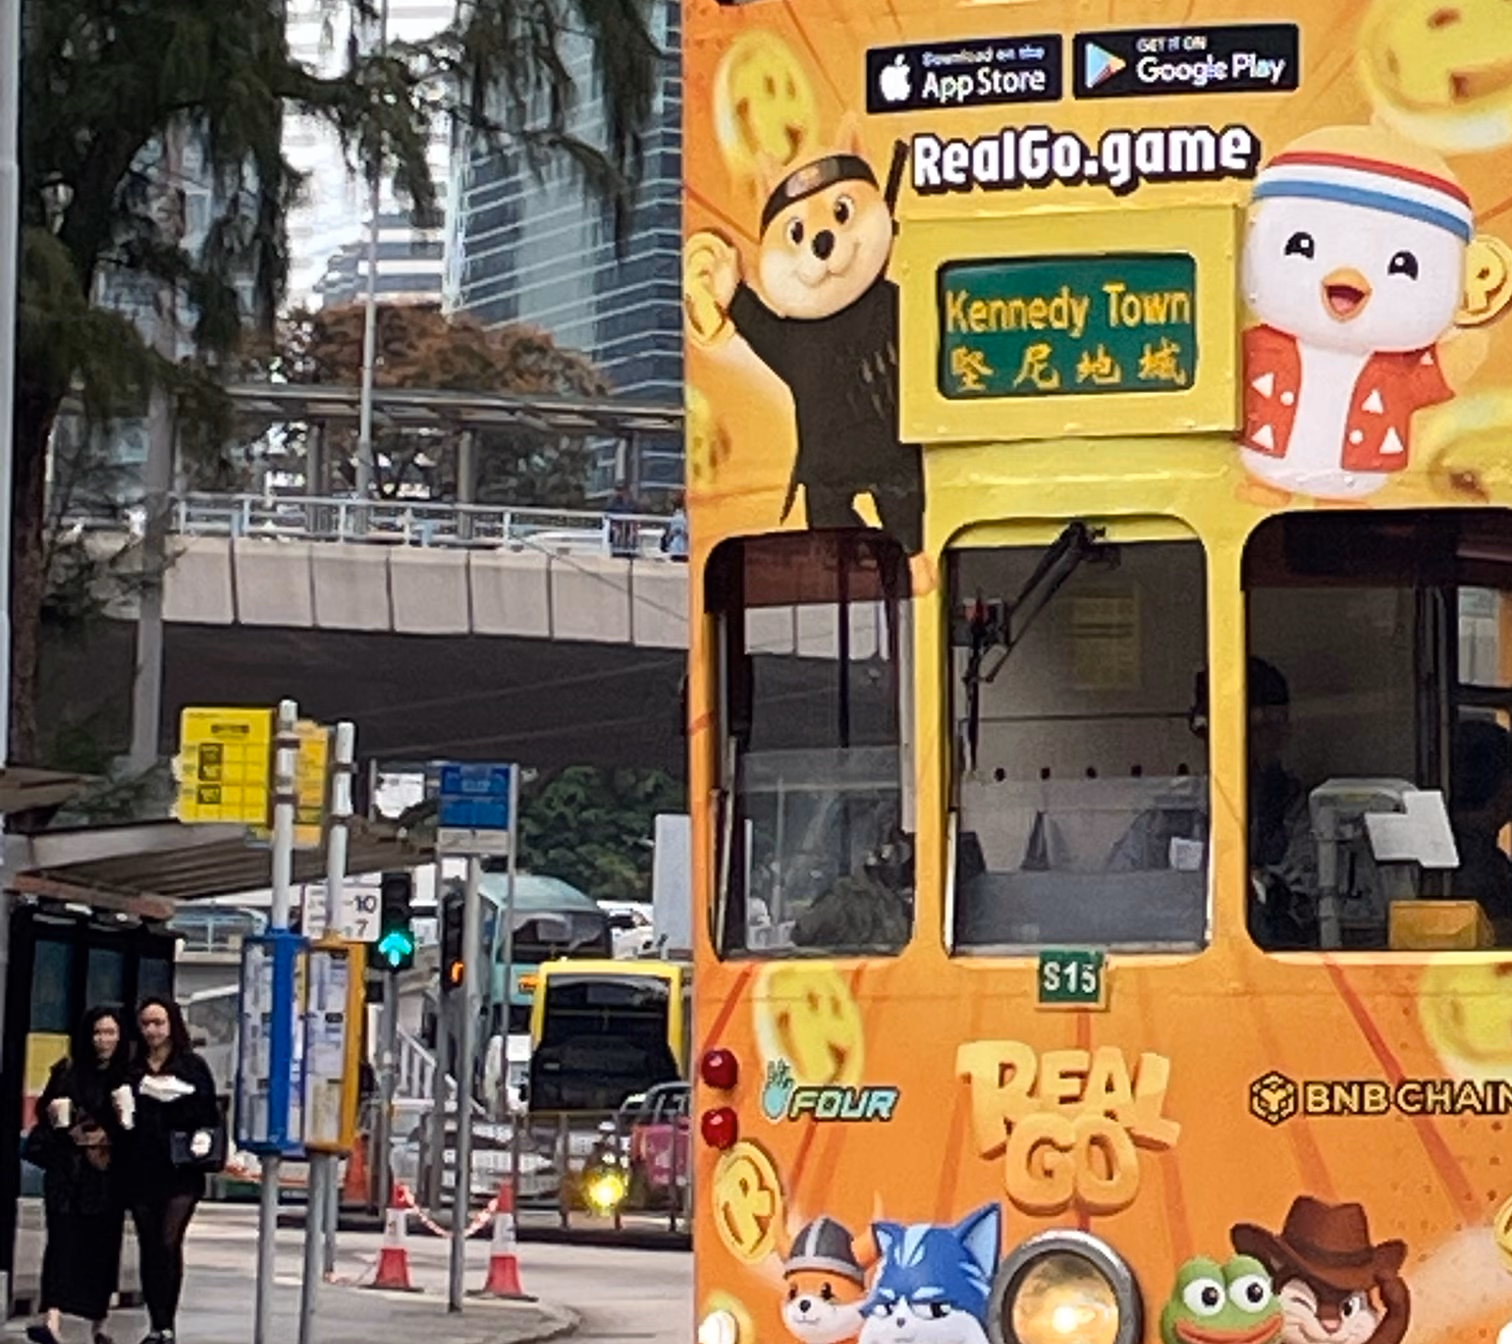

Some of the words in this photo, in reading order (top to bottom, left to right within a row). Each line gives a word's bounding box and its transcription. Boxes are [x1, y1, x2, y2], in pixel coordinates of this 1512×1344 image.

[921, 71, 974, 103] App
[977, 66, 1046, 96] Store
[1135, 54, 1228, 87] Google
[1231, 52, 1287, 85] Play
[912, 125, 1253, 187] RealGo.game
[946, 285, 1090, 338] Kennedy
[1102, 281, 1191, 327] Town
[950, 336, 1187, 391] 堅尼地城
[1042, 959, 1097, 994] S15
[789, 1087, 900, 1121] FOUR
[955, 1039, 1181, 1159] REAL
[1303, 1081, 1389, 1113] BNB
[1004, 1112, 1141, 1218] GO
